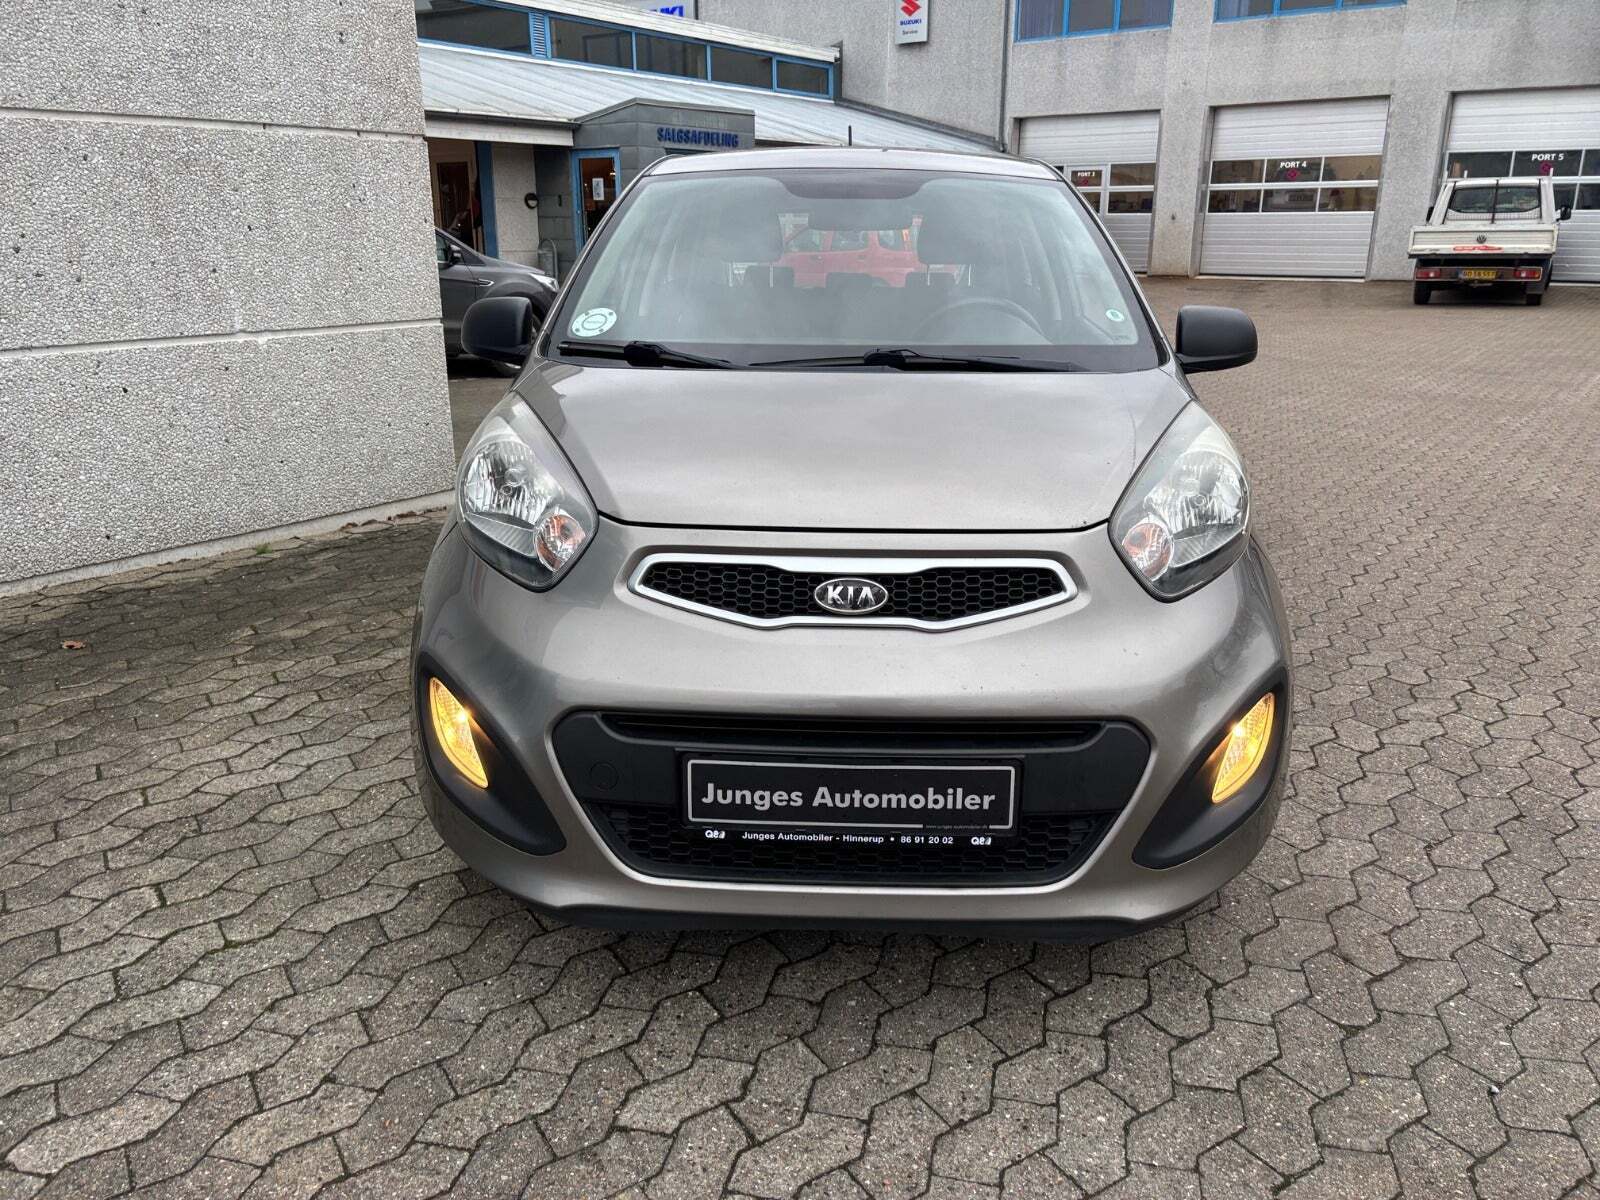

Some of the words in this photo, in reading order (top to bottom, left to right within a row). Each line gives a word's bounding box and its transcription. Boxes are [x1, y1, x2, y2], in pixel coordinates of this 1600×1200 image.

[657, 127, 739, 148] SALGSAFDELING
[1531, 153, 1556, 161] PORT
[1558, 153, 1564, 161] 5
[827, 585, 876, 605] KIA
[701, 783, 803, 811] Junges
[812, 786, 996, 810] Automobiler
[742, 832, 775, 841] Junges
[778, 833, 833, 841] Automobiler
[842, 834, 884, 844] Hinnerup
[900, 835, 912, 844] 86
[914, 836, 924, 844] 91
[928, 836, 940, 844] 20
[942, 836, 954, 844] 02
